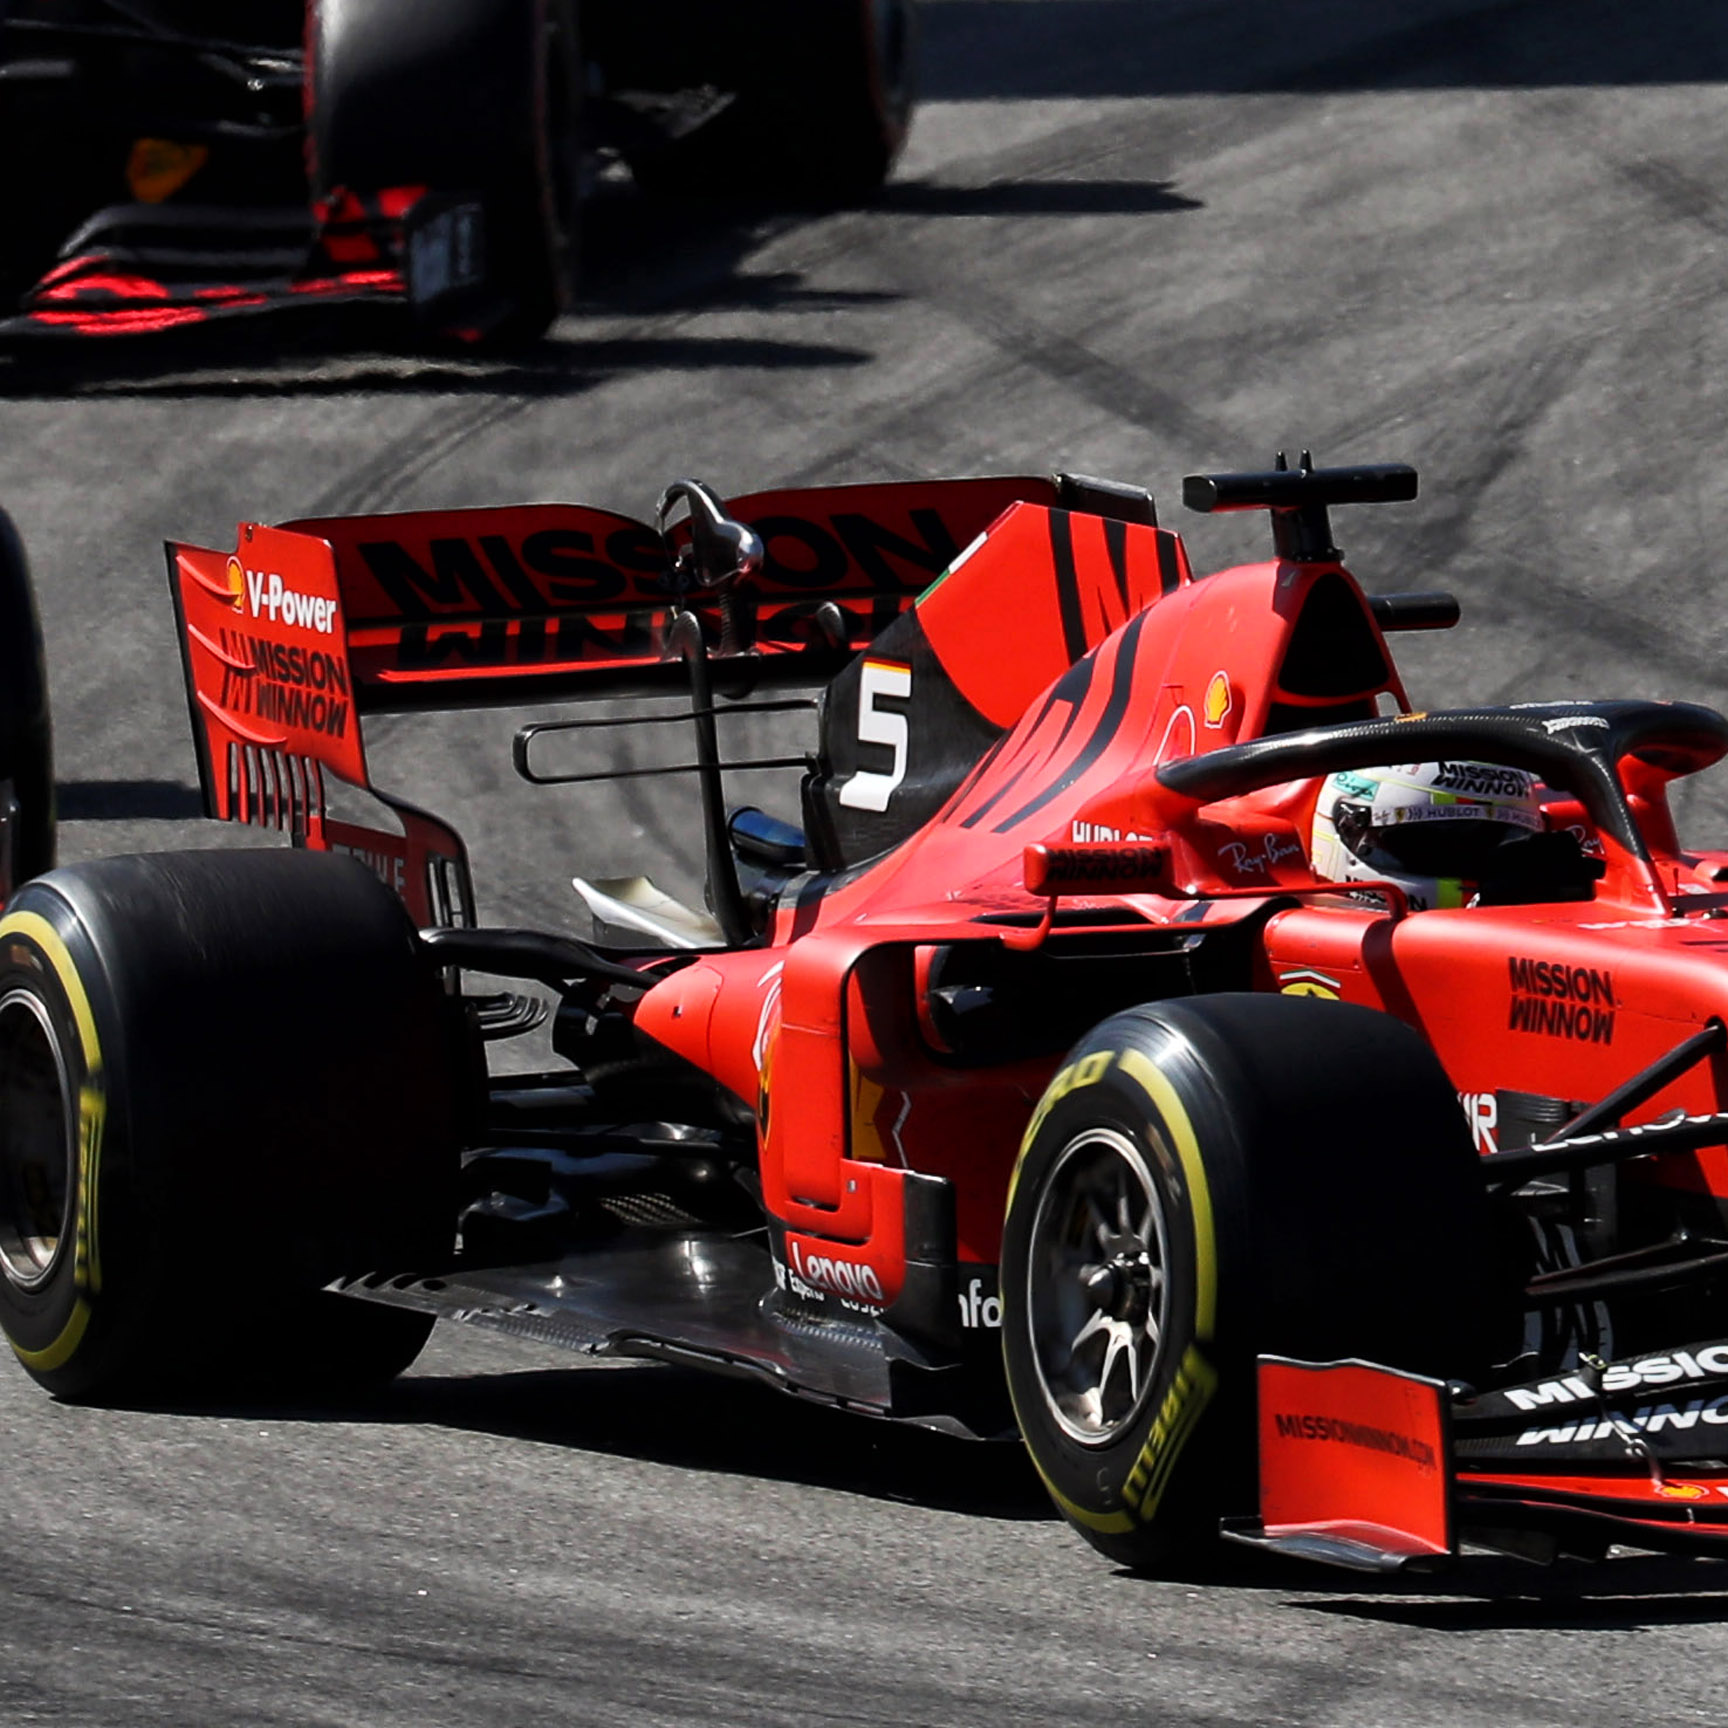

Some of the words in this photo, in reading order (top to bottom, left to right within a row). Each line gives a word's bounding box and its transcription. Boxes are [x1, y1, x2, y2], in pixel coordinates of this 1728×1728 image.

[358, 508, 958, 617] MISSON
[246, 569, 338, 635] V-Power
[249, 636, 346, 694] MISSION
[256, 681, 347, 739] WINNOW
[839, 658, 912, 814] 5
[1218, 833, 1301, 873] Ray-Ban
[1509, 957, 1614, 1005] MISSION
[1509, 995, 1615, 1045] WINNOW
[791, 1241, 884, 1301] Lenovo
